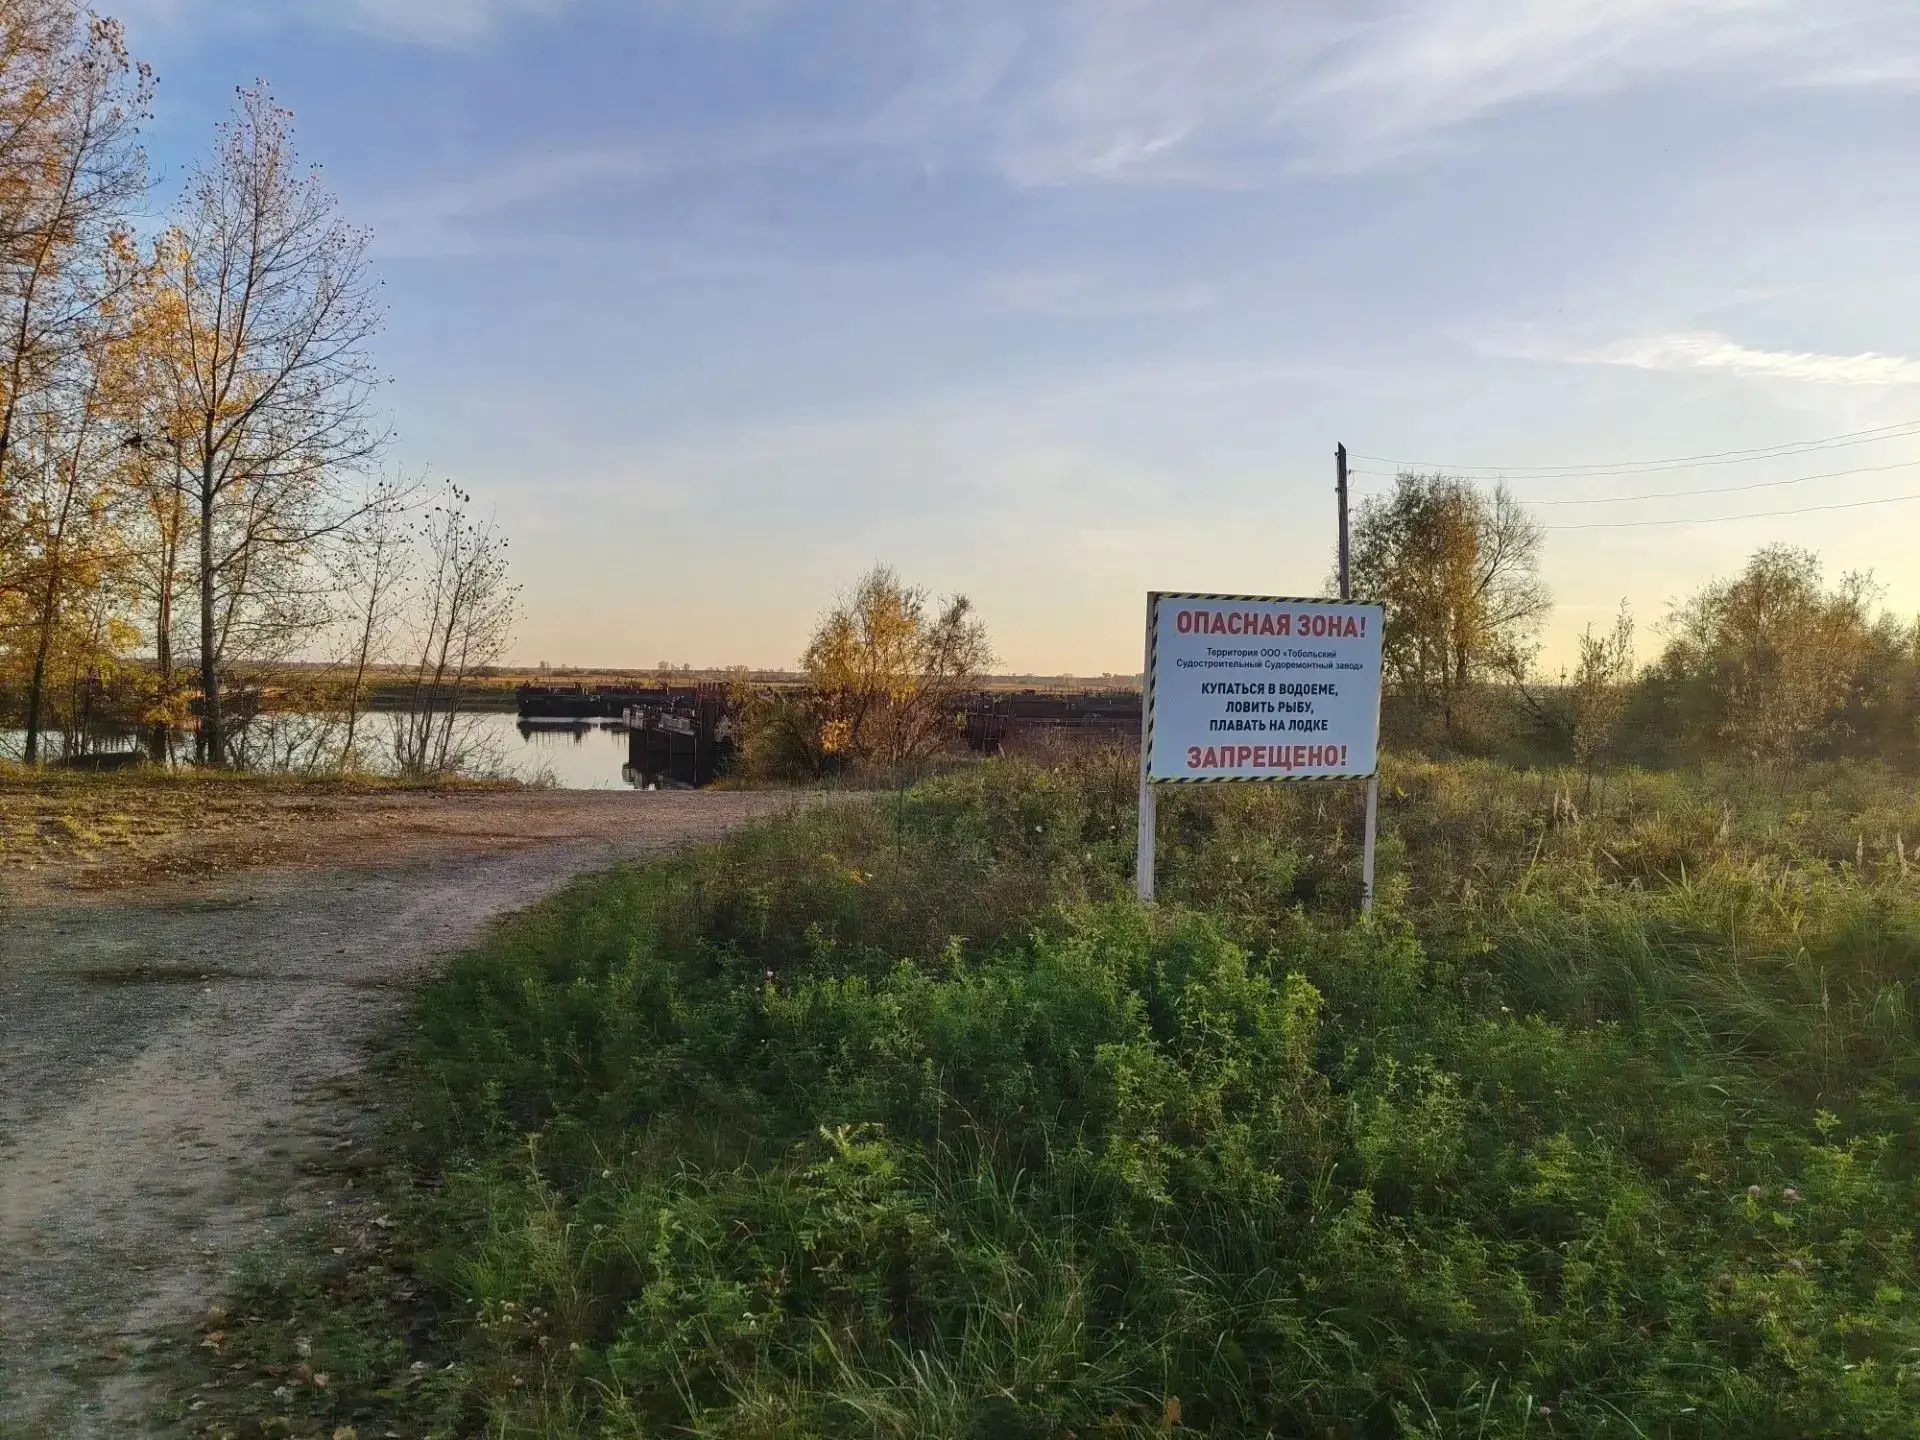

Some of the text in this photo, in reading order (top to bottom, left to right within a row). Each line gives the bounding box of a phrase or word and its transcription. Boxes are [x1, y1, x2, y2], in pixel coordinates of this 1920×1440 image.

[1177, 611, 1366, 637] ОПАСНАЯ ЗОНА!
[1207, 648, 1336, 658] Территория ООО «Тобольский
[1177, 659, 1262, 669] Судостроительный
[1265, 660, 1333, 670] Судоремонтный
[1202, 683, 1338, 697] КУПАТЬСЯ В ВОДОЕМЕ,
[1226, 702, 1313, 714] ЛОВИТЬ РЫБУ,
[1210, 720, 1328, 732] ПЛАВАТЬ НА ЛОДКЕ
[1187, 746, 1347, 770] ЗАПРЕЩЕНО!
